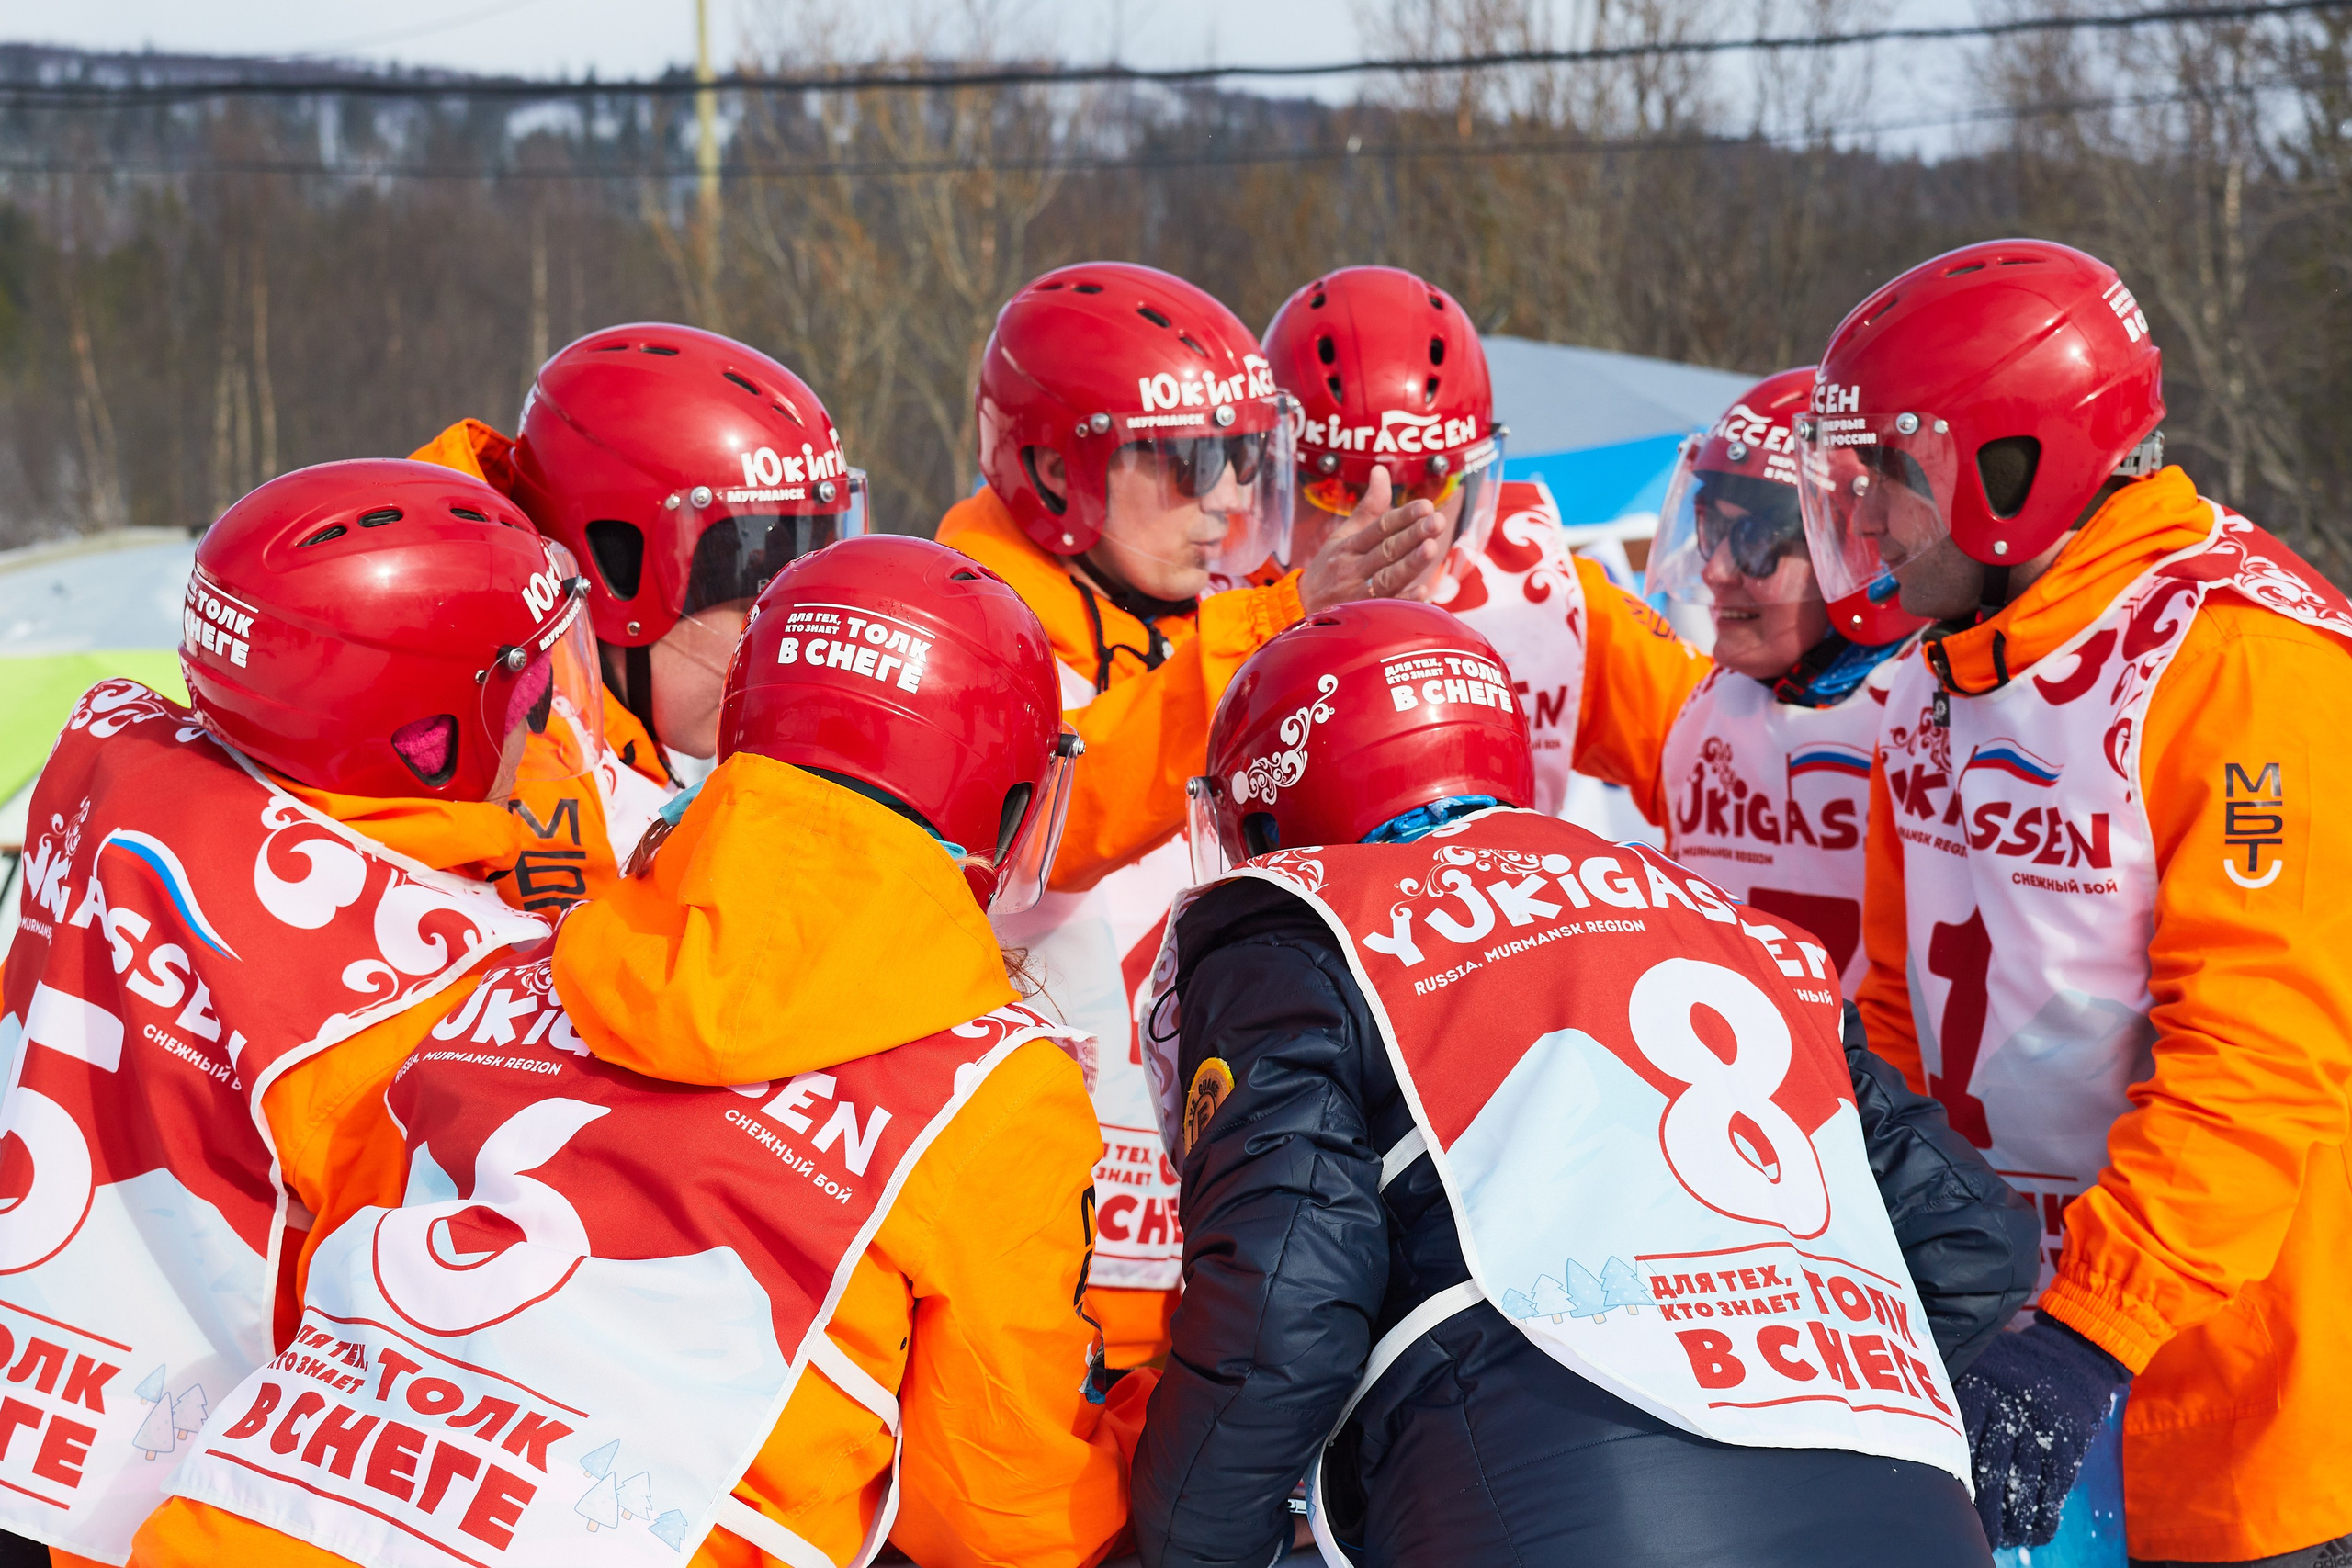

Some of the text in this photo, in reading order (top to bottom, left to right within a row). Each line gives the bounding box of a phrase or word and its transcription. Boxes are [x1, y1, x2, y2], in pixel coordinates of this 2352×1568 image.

[1126, 413, 1205, 429] МУРМАНСК
[727, 488, 806, 502] МУРМАНСК
[198, 589, 255, 638] ТОЛК
[787, 612, 814, 624] ДЛЯ
[785, 616, 932, 663] КТО ЗНАЕТ ТОЛК
[777, 637, 924, 694] В СНЕГЕ
[1385, 657, 1442, 678] ДЛЯ ТЕХ,
[1386, 657, 1507, 689] КТО ЗНАЕТ ТОЛК
[1390, 685, 1419, 712] В
[1421, 678, 1514, 714] СНЕГЕ
[2012, 872, 2118, 895] СНЕЖНЫЙ БОЙ
[20, 916, 53, 946] MURMANS
[1414, 919, 1646, 997] RUSSIA, MURMANSK REGION
[143, 1023, 231, 1083] СНЕЖНЫЙ
[423, 1051, 504, 1067] MURMANSK
[504, 1056, 562, 1076] REGION
[1628, 957, 1831, 1241] 8
[0, 979, 126, 1275] 5
[724, 1109, 854, 1204] СНЕЖНЫЙ БОЙ
[1096, 1166, 1152, 1186] ЗНАЕТ
[372, 1097, 612, 1337] 6
[1649, 1264, 1792, 1300] ДЛЯ ТЕХ,
[1660, 1264, 1919, 1350] КТО ЗНАЕТ ТОЛК
[327, 1340, 369, 1373] ТЕХ,
[1675, 1321, 1955, 1417] В СНЕГЕ
[296, 1355, 367, 1395] ЗНАЕТ
[375, 1347, 574, 1474] ТОЛК
[222, 1382, 538, 1552] В СНЕГЕ
